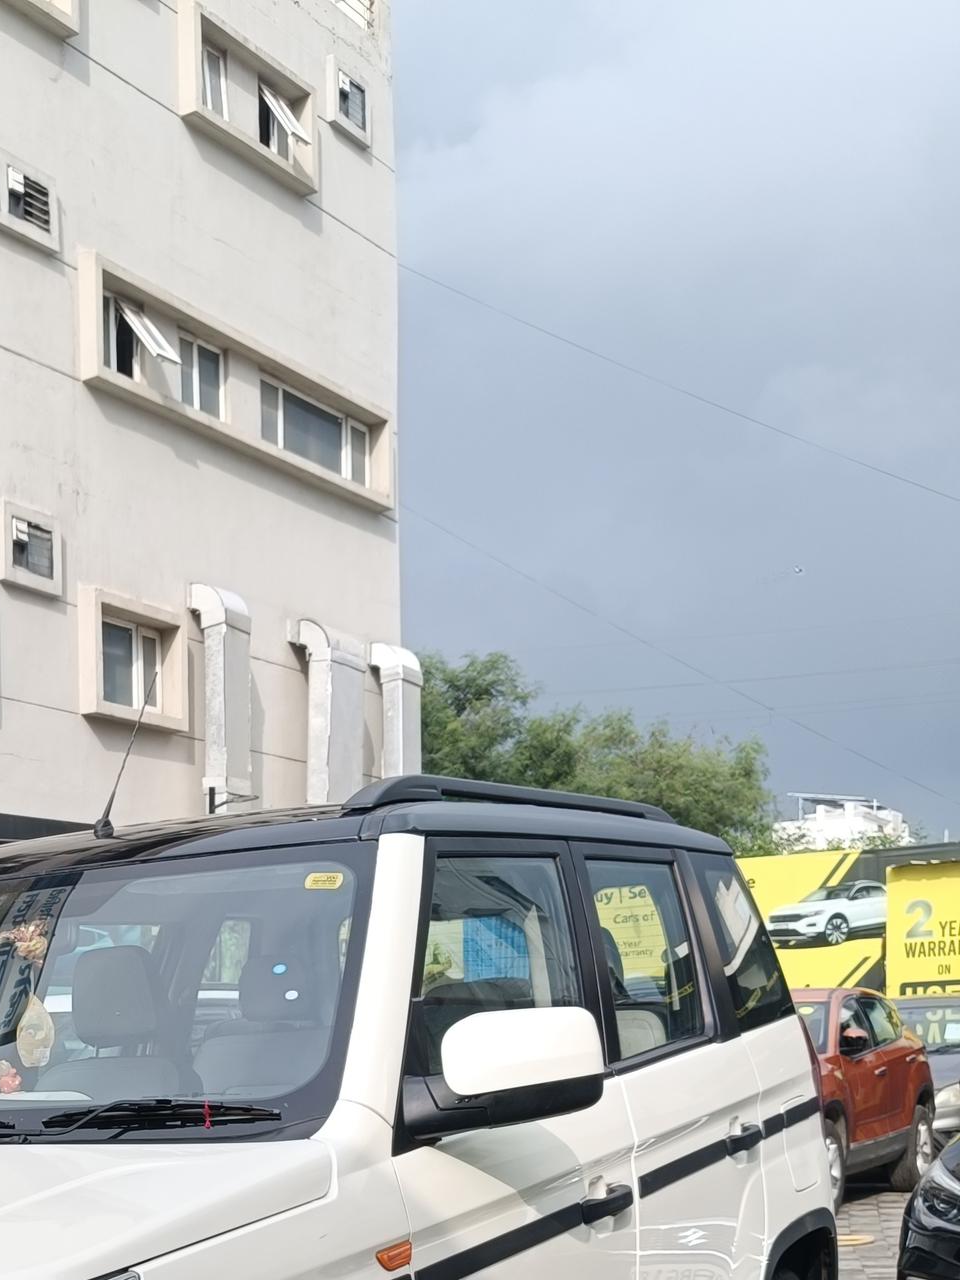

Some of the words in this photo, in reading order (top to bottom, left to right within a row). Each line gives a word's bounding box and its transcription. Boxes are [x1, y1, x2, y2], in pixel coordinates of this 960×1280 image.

[595, 892, 613, 906] uy
[613, 913, 640, 924] Cars
[642, 910, 656, 922] of
[905, 899, 933, 939] 2
[939, 920, 960, 938] YE
[621, 948, 654, 957] arranty
[904, 939, 960, 958] WARRA
[937, 964, 951, 976] ON
